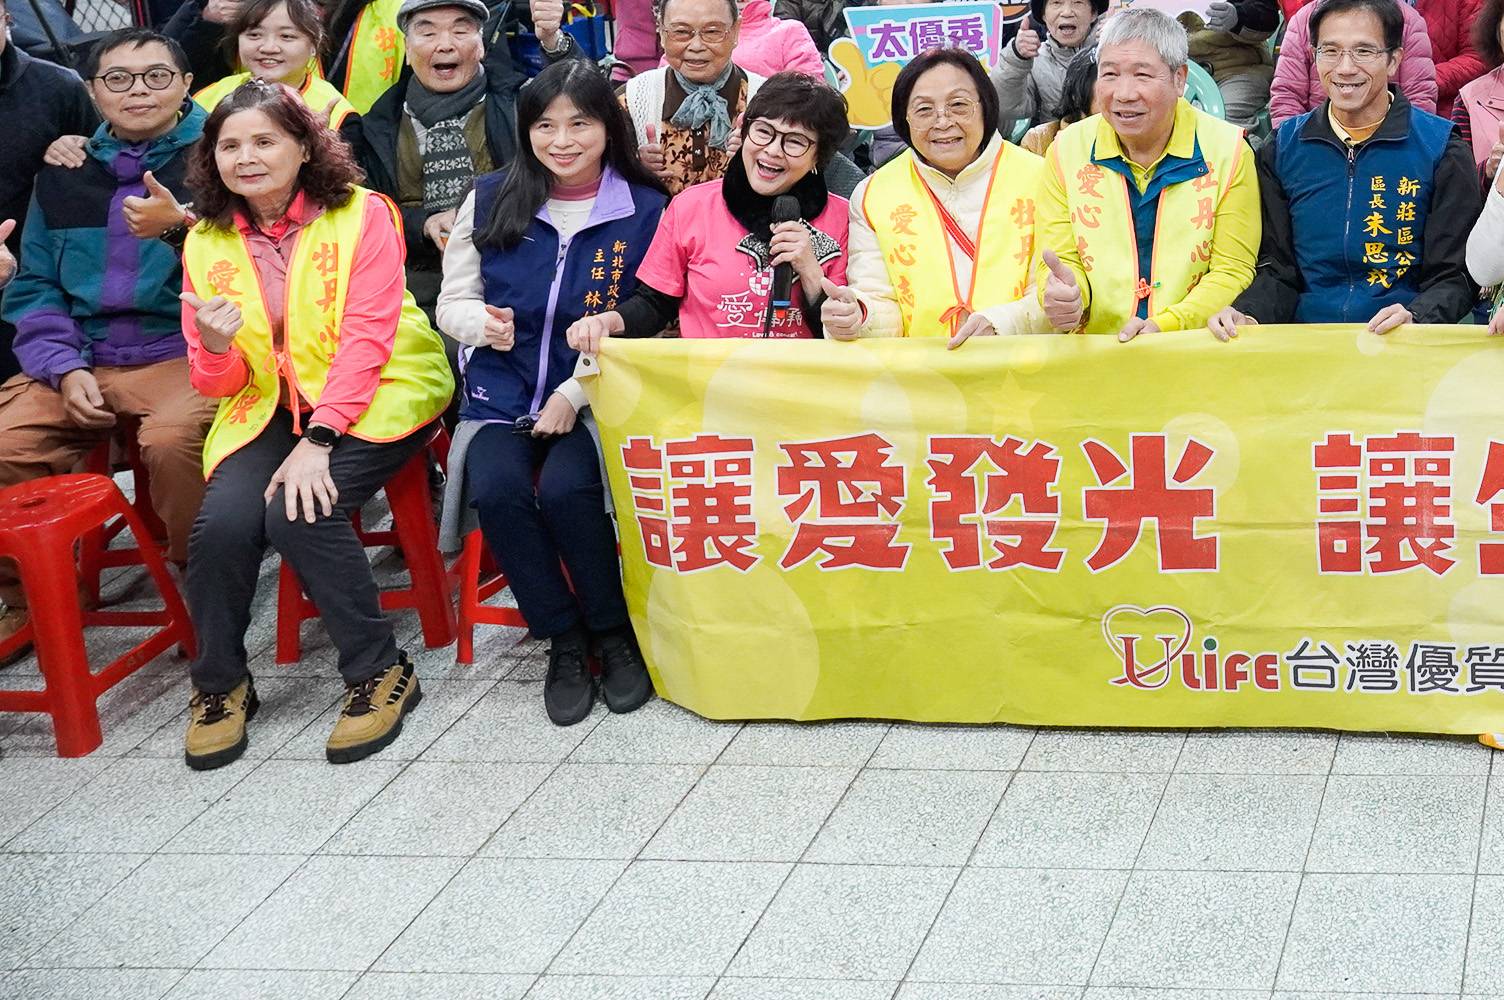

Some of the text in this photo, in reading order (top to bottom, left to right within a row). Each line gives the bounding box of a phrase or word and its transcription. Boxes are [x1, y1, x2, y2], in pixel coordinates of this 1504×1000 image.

[870, 16, 985, 60] 太優秀
[1186, 161, 1220, 293] 牡丹心
[1368, 175, 1387, 209] 區長
[311, 242, 341, 366] 牡丹心
[590, 248, 606, 281] 主任
[603, 239, 628, 312] 新北市政府
[889, 203, 918, 322] 愛心志
[624, 435, 1216, 571] 讓愛發光
